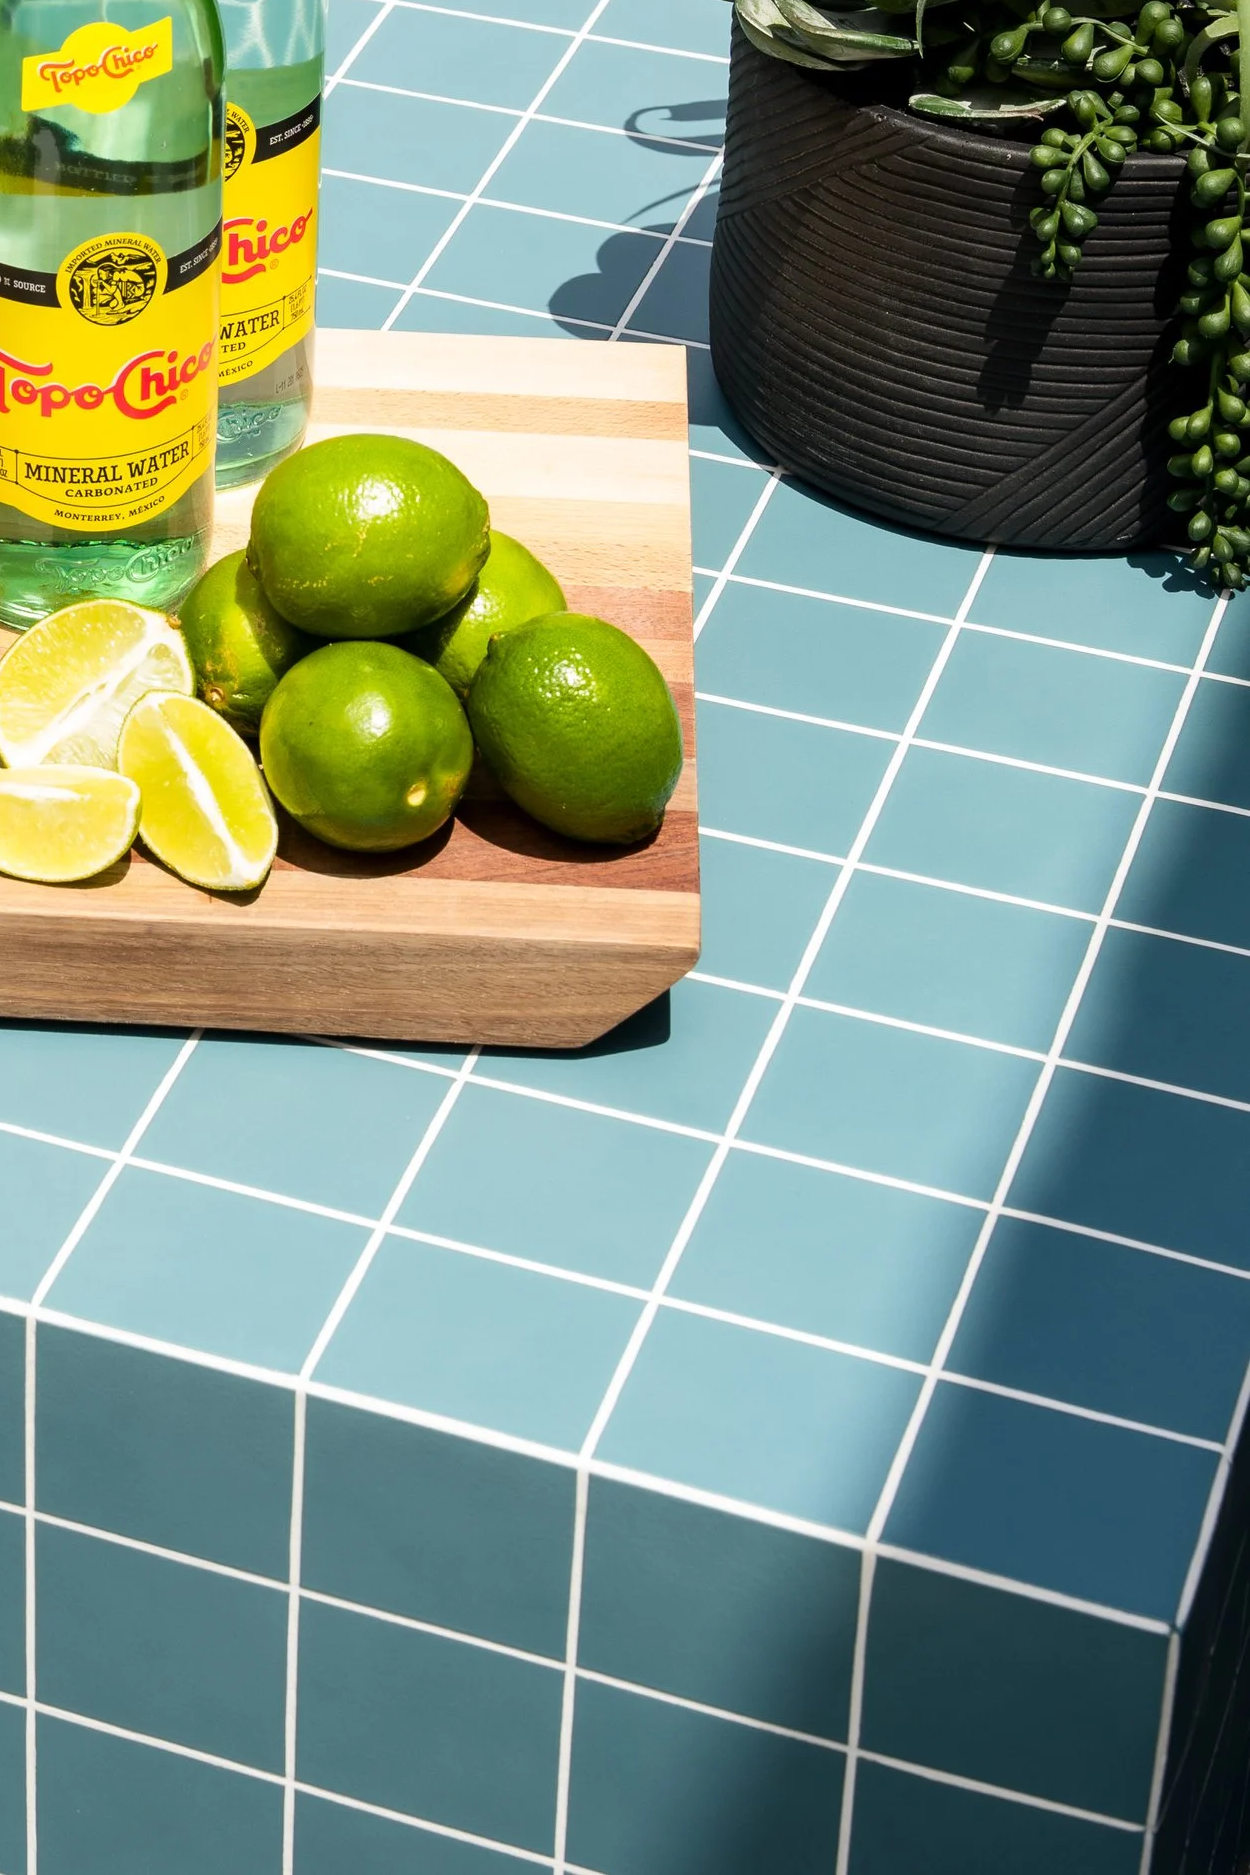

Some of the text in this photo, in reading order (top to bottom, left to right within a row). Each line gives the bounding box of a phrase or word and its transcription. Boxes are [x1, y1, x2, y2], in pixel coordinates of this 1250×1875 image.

[38, 41, 160, 93] Topo Chico
[231, 110, 250, 134] WATER
[269, 123, 302, 146] EST. SINCE
[65, 237, 162, 274] IMPORTED MINERAL WATER
[179, 248, 209, 274] EST. SINCE
[13, 279, 46, 294] SOURCE
[107, 331, 218, 420] Chico
[24, 440, 190, 485] MINERAL WATER
[64, 476, 159, 498] CARBONATED
[54, 494, 166, 523] MONTERREY, MÉXICO
